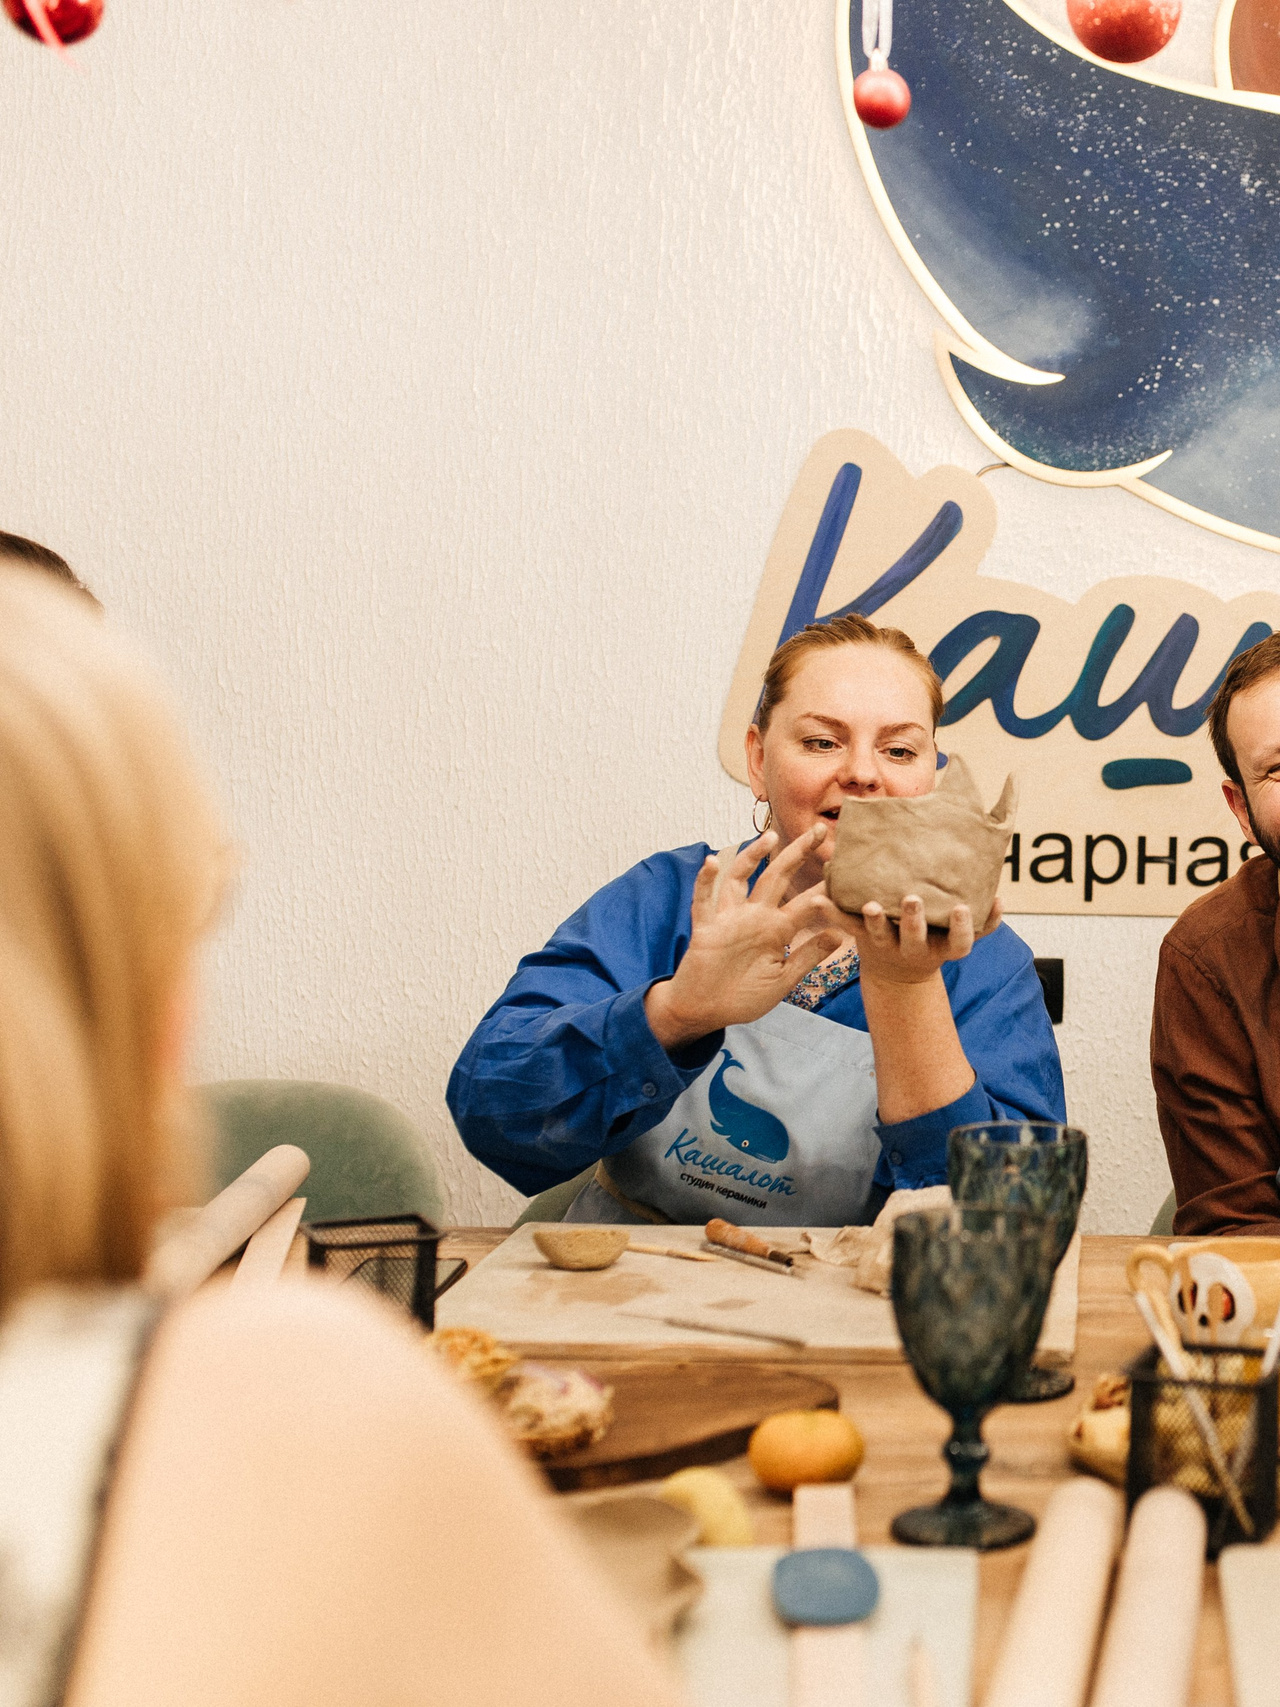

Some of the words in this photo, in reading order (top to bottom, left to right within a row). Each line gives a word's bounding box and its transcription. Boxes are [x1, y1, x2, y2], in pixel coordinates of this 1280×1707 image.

[664, 1128, 798, 1195] Кашалот
[680, 1172, 716, 1191] студия
[715, 1185, 768, 1209] керамики
